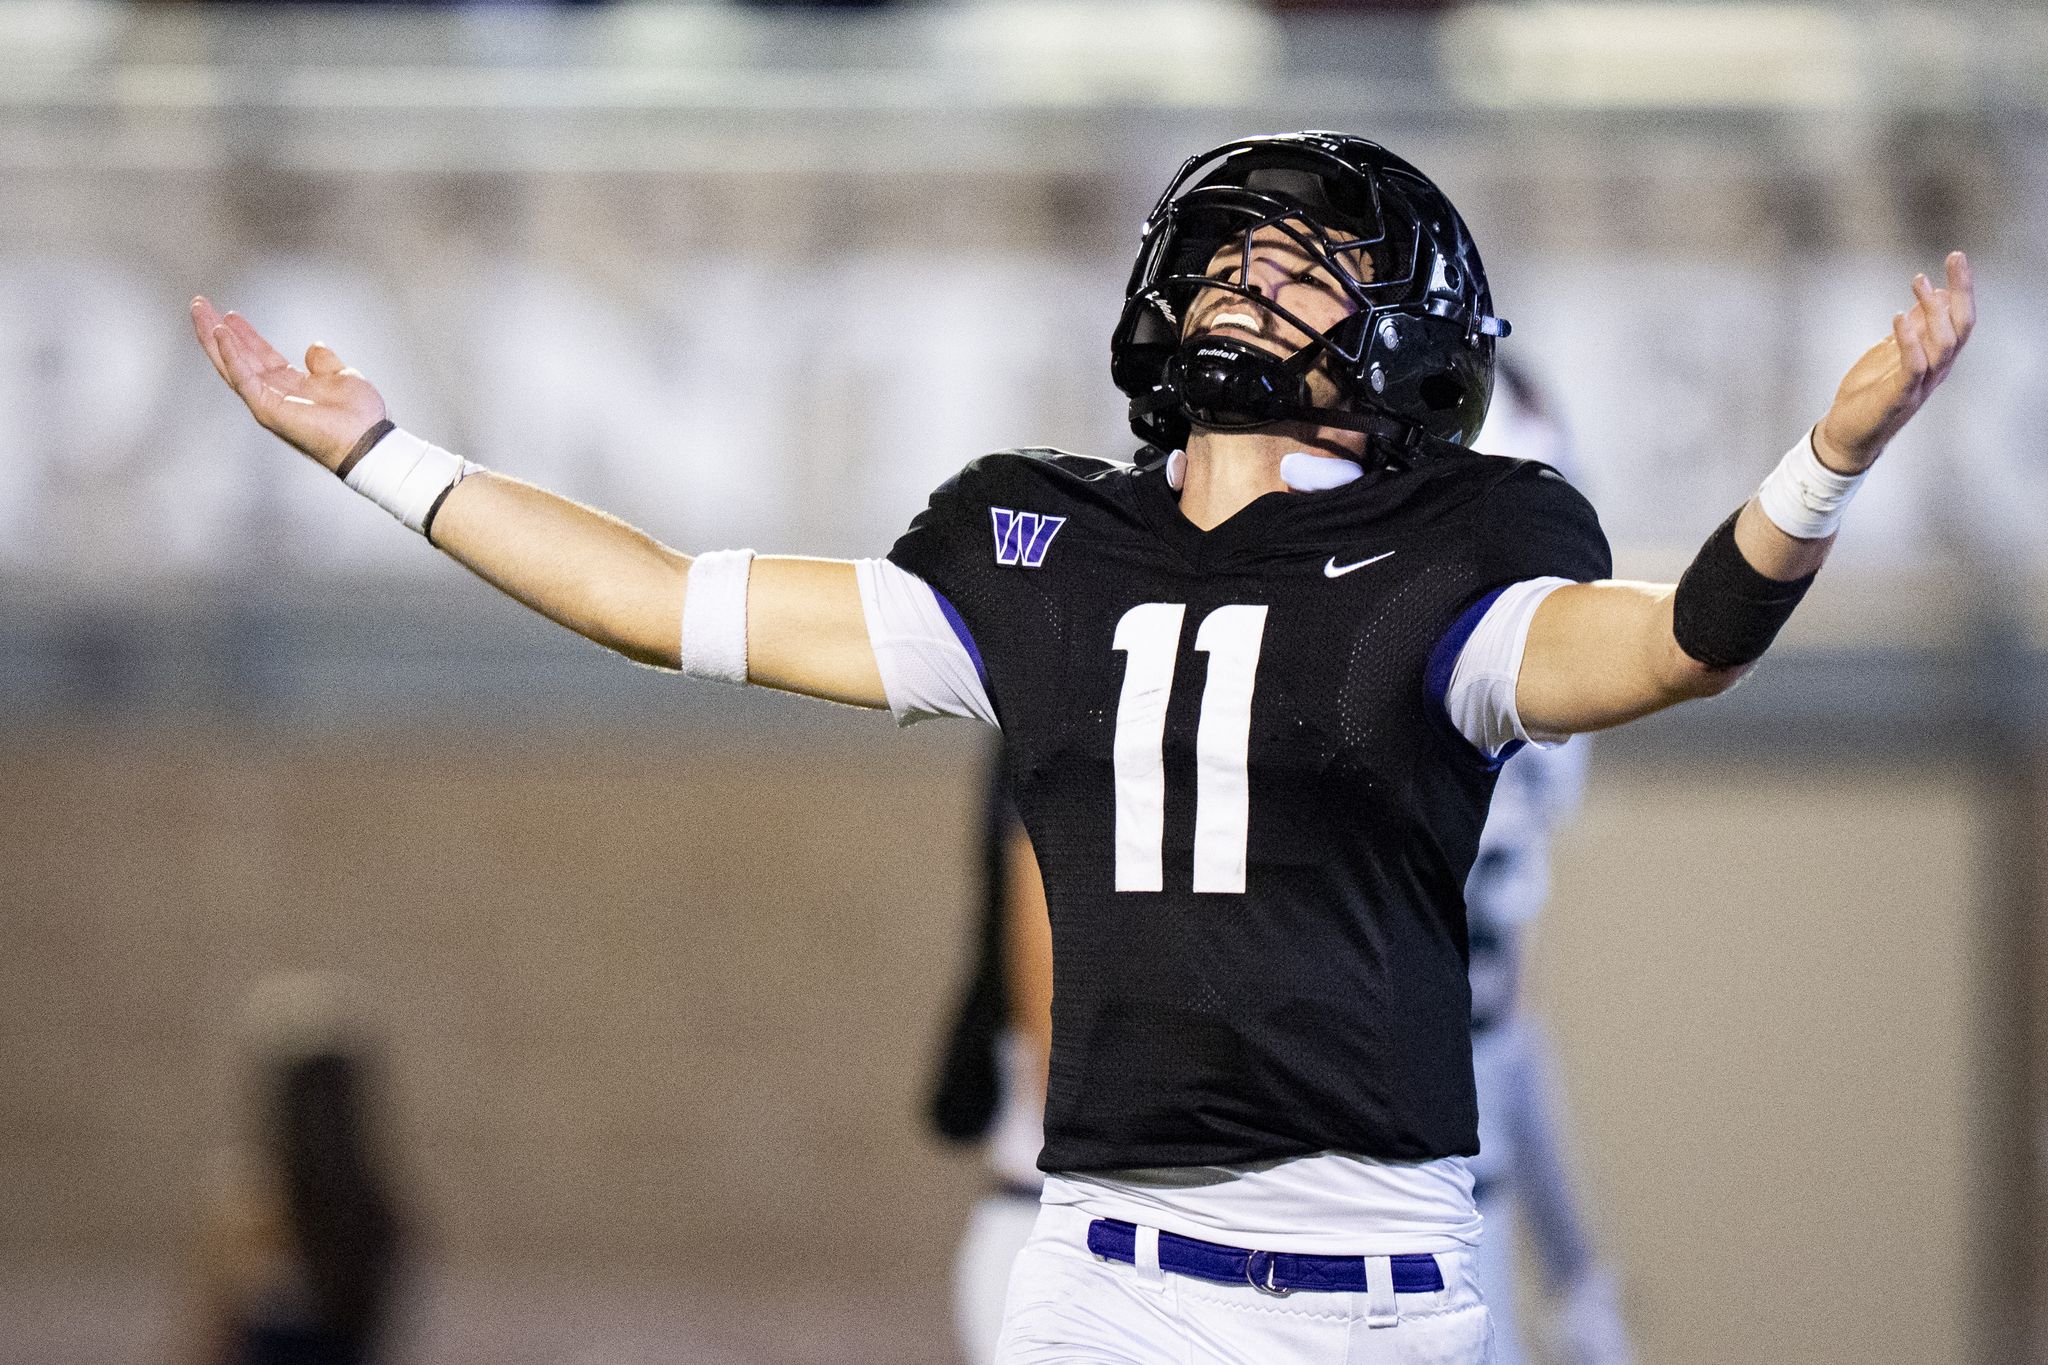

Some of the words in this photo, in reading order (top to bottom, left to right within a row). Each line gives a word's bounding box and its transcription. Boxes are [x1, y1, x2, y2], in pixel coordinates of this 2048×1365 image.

[1198, 348, 1239, 361] Riddell
[991, 507, 1067, 568] W
[1112, 603, 1268, 894] 11
